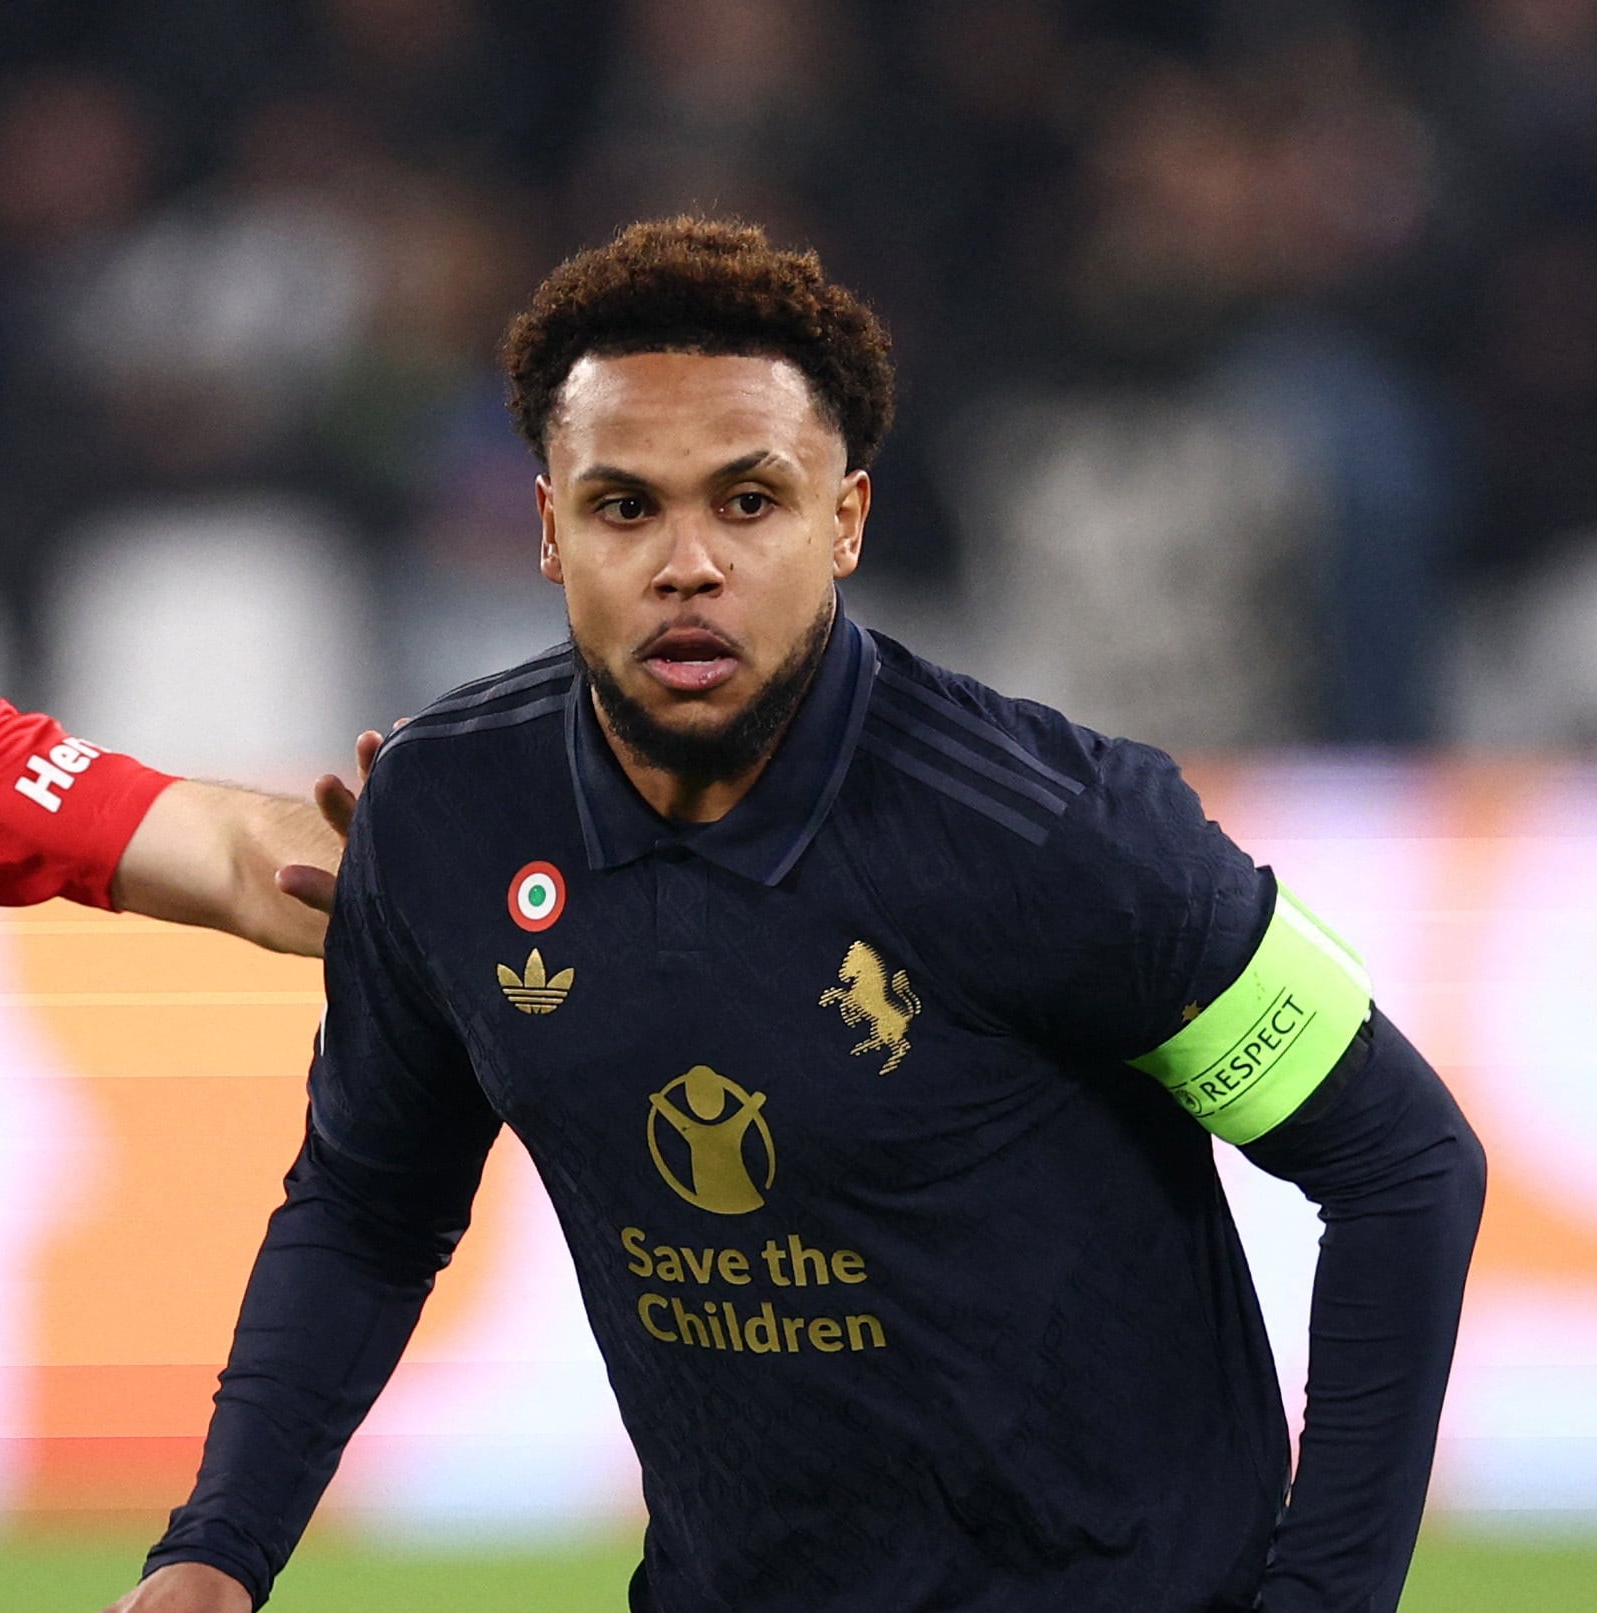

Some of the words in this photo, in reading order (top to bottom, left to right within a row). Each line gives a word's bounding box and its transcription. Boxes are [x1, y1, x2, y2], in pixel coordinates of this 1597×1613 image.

[1200, 994, 1304, 1103] RESPECT
[620, 1227, 751, 1285] Save
[761, 1234, 868, 1286] the
[638, 1293, 887, 1353] Children
